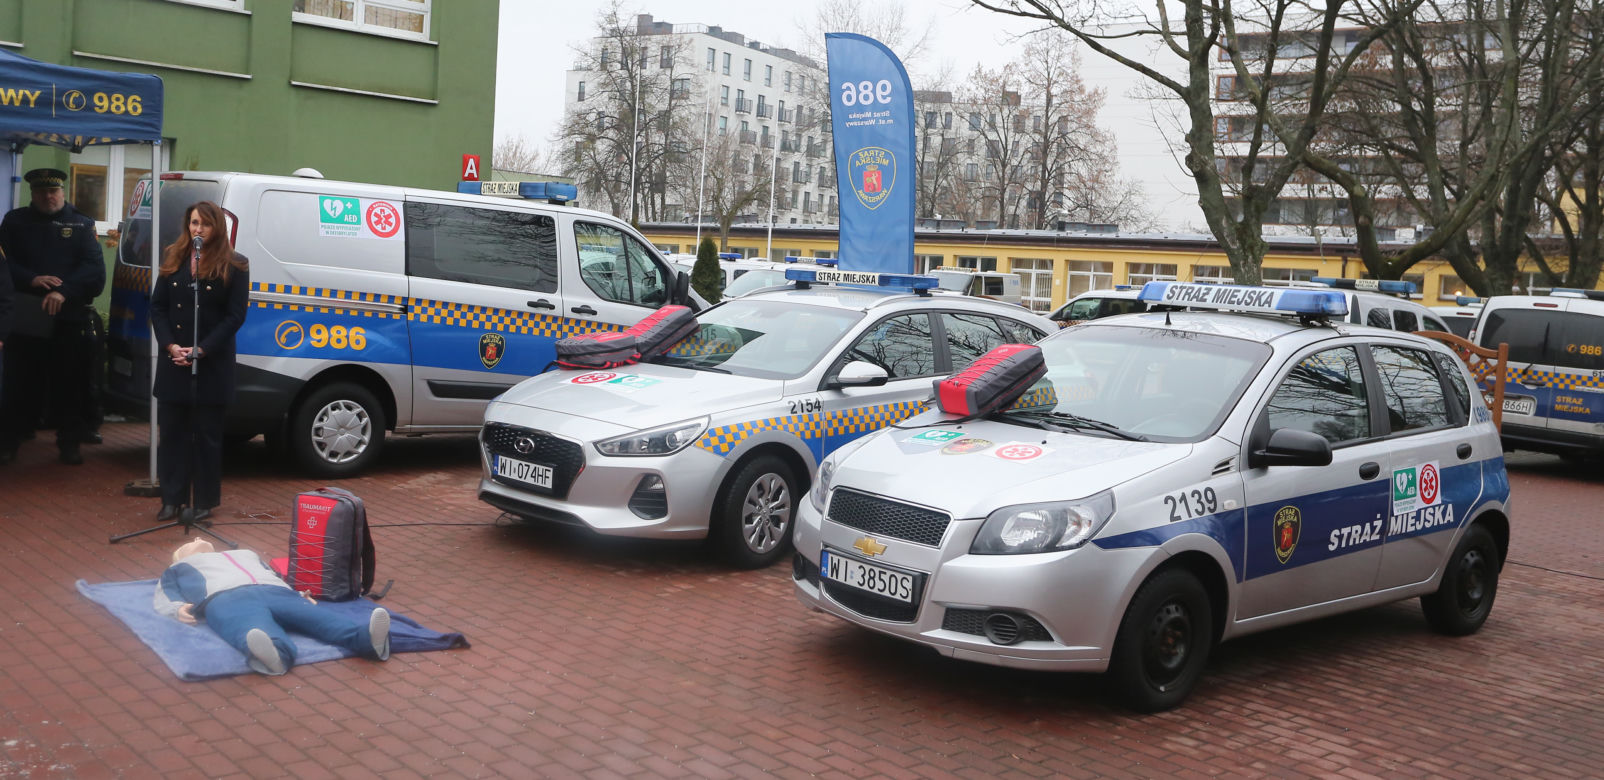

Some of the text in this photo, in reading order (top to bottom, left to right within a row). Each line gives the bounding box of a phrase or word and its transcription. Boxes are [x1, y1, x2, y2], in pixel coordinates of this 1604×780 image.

[93, 92, 143, 116] 986
[464, 158, 478, 178] A
[497, 182, 518, 194] MIEJSKA
[344, 214, 358, 222] AED
[843, 273, 876, 285] MIEJSKA
[1211, 289, 1275, 308] MIEJSKA
[309, 323, 367, 351] 986
[1579, 344, 1602, 356] 986
[787, 397, 822, 415] 2154
[1555, 404, 1591, 414] MIEJSKA
[500, 458, 551, 486] WI 074HF
[1407, 486, 1416, 496] AED
[1163, 486, 1218, 522] 2139
[1328, 513, 1383, 552] STRAŻ
[1388, 503, 1454, 537] MIEJSKA
[830, 555, 849, 583] WI
